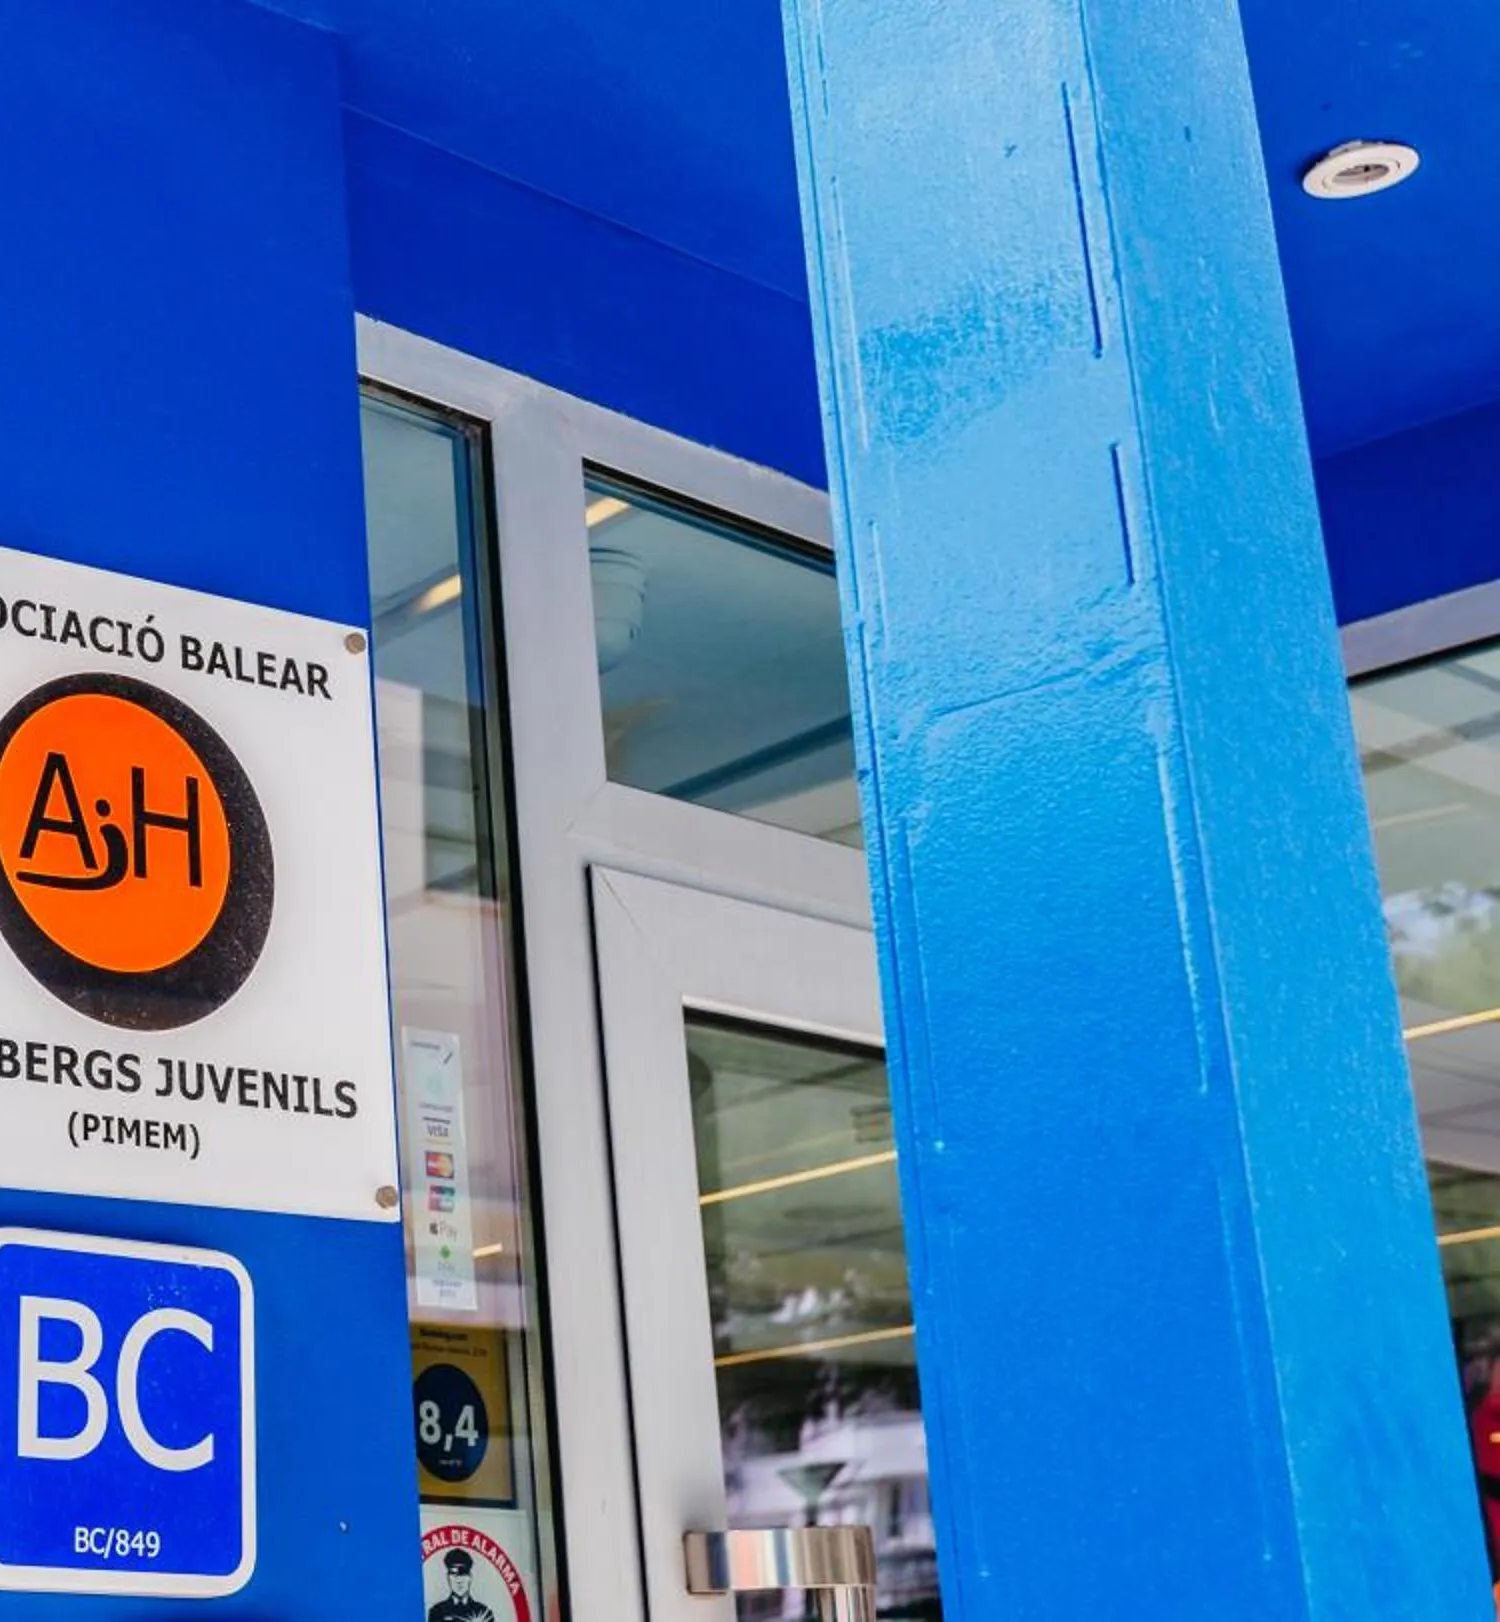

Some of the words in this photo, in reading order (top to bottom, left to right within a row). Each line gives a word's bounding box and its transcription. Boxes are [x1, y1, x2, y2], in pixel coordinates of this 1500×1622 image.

[179, 634, 333, 700] BALEAR
[155, 1057, 359, 1119] JUVENILS
[67, 1110, 201, 1160] (PIMEM)
[17, 1294, 214, 1472] BC
[419, 1399, 480, 1453] 8,4
[74, 1526, 161, 1560] BC/849
[421, 1531, 449, 1561] RAL
[451, 1529, 470, 1545] DE
[471, 1534, 520, 1596] ALARMA
